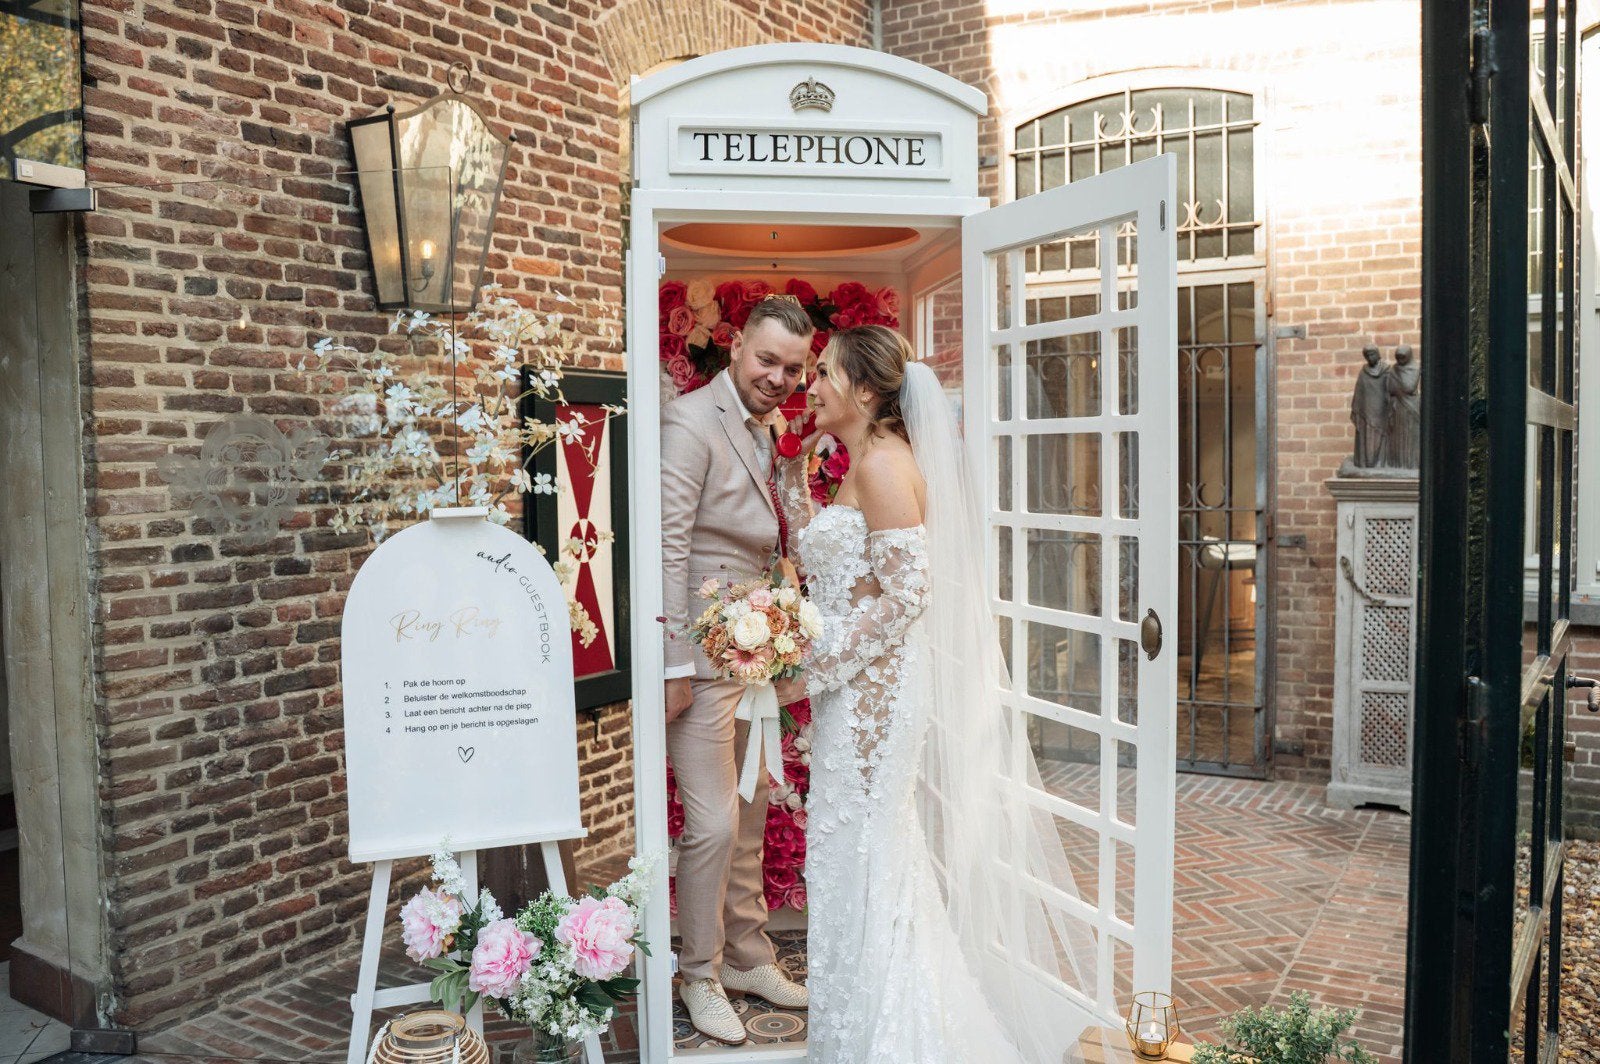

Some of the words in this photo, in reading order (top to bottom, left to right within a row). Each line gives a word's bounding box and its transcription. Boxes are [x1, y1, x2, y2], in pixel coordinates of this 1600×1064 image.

[693, 132, 926, 167] TELEPHONE
[477, 551, 518, 574] audio
[519, 575, 551, 664] GUESTBOOK
[389, 609, 446, 643] Ring
[449, 606, 503, 640] Ring
[403, 694, 437, 703] Beluister
[451, 689, 527, 699] welkomstboodschap
[404, 710, 422, 718] Laat
[440, 706, 466, 715] bericht
[468, 705, 491, 713] achter
[516, 702, 532, 711] piep
[404, 725, 426, 734] Hang
[427, 724, 438, 732] op
[450, 723, 459, 732] je
[460, 721, 487, 729] bericht
[496, 717, 539, 728] opgeslagen
